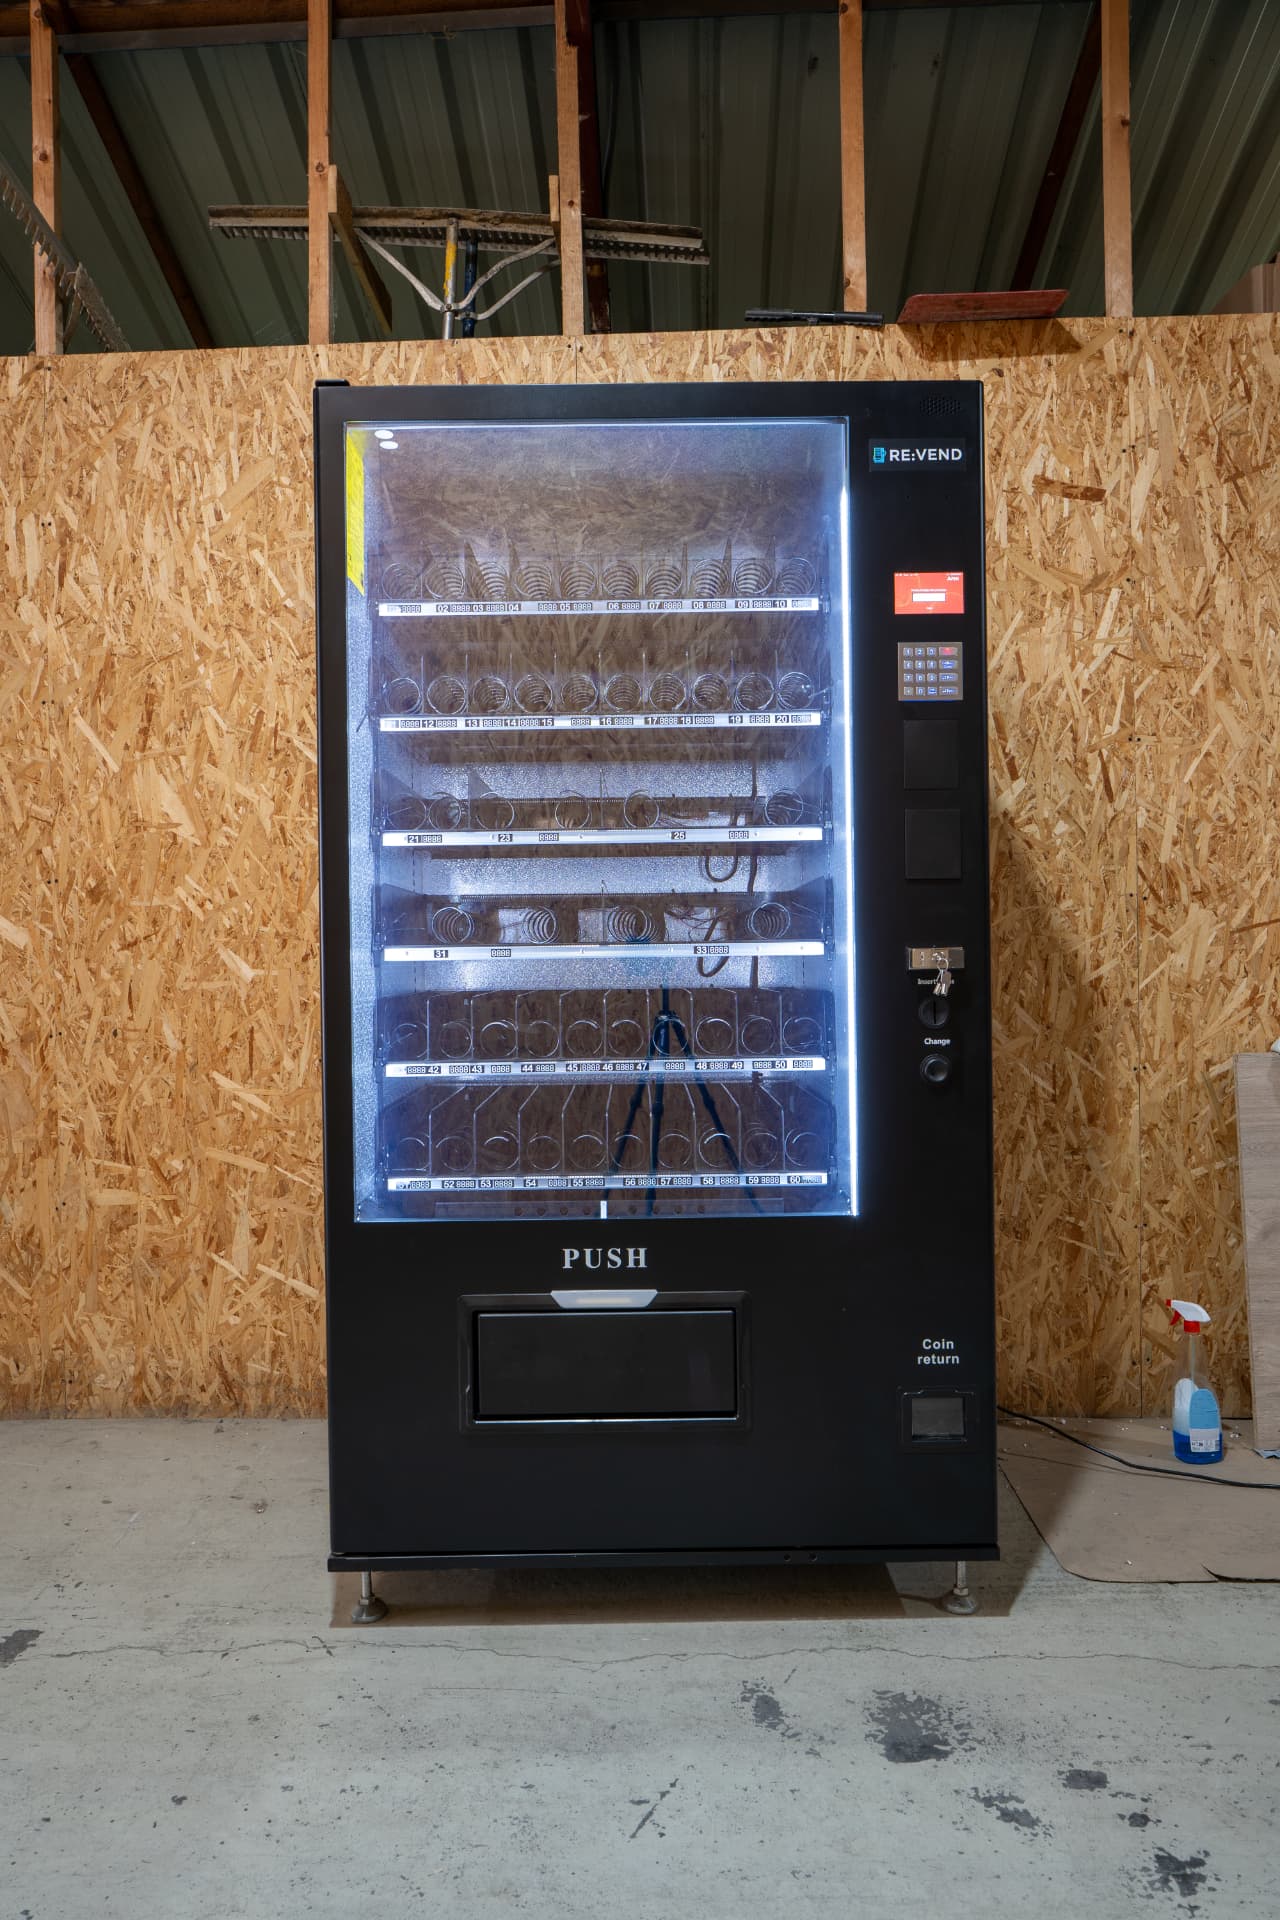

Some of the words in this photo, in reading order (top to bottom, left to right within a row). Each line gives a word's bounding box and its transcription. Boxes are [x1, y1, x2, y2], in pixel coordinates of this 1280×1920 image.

[889, 448, 962, 462] RE:VEND
[473, 604, 483, 612] 03
[560, 603, 571, 611] 05
[649, 601, 659, 609] 07
[693, 601, 704, 609] 08
[737, 600, 748, 608] 09
[775, 600, 786, 608] 10
[423, 720, 435, 728] 12
[541, 718, 552, 726] 15
[601, 717, 612, 725] 16
[647, 717, 658, 725] 17
[680, 716, 691, 724] 18
[730, 715, 740, 723] 19
[777, 715, 788, 723] 20
[408, 835, 419, 843] 21
[499, 834, 510, 842] 23
[696, 946, 707, 954] 33
[924, 1038, 950, 1046] Change
[428, 1066, 439, 1074] 42
[471, 1065, 482, 1073] 43
[567, 1064, 578, 1072] 45
[602, 1063, 614, 1071] 46
[636, 1062, 647, 1070] 47
[696, 1062, 707, 1070] 48
[731, 1061, 743, 1069] 49
[443, 1180, 455, 1188] 52
[525, 1179, 536, 1187] 54
[572, 1179, 583, 1187] 55
[660, 1177, 671, 1185] 57
[703, 1177, 714, 1185] 58
[748, 1176, 759, 1184] 59
[789, 1176, 800, 1184] 60
[562, 1247, 648, 1269] PUSH
[922, 1338, 954, 1350] Coin
[917, 1354, 960, 1365] return
